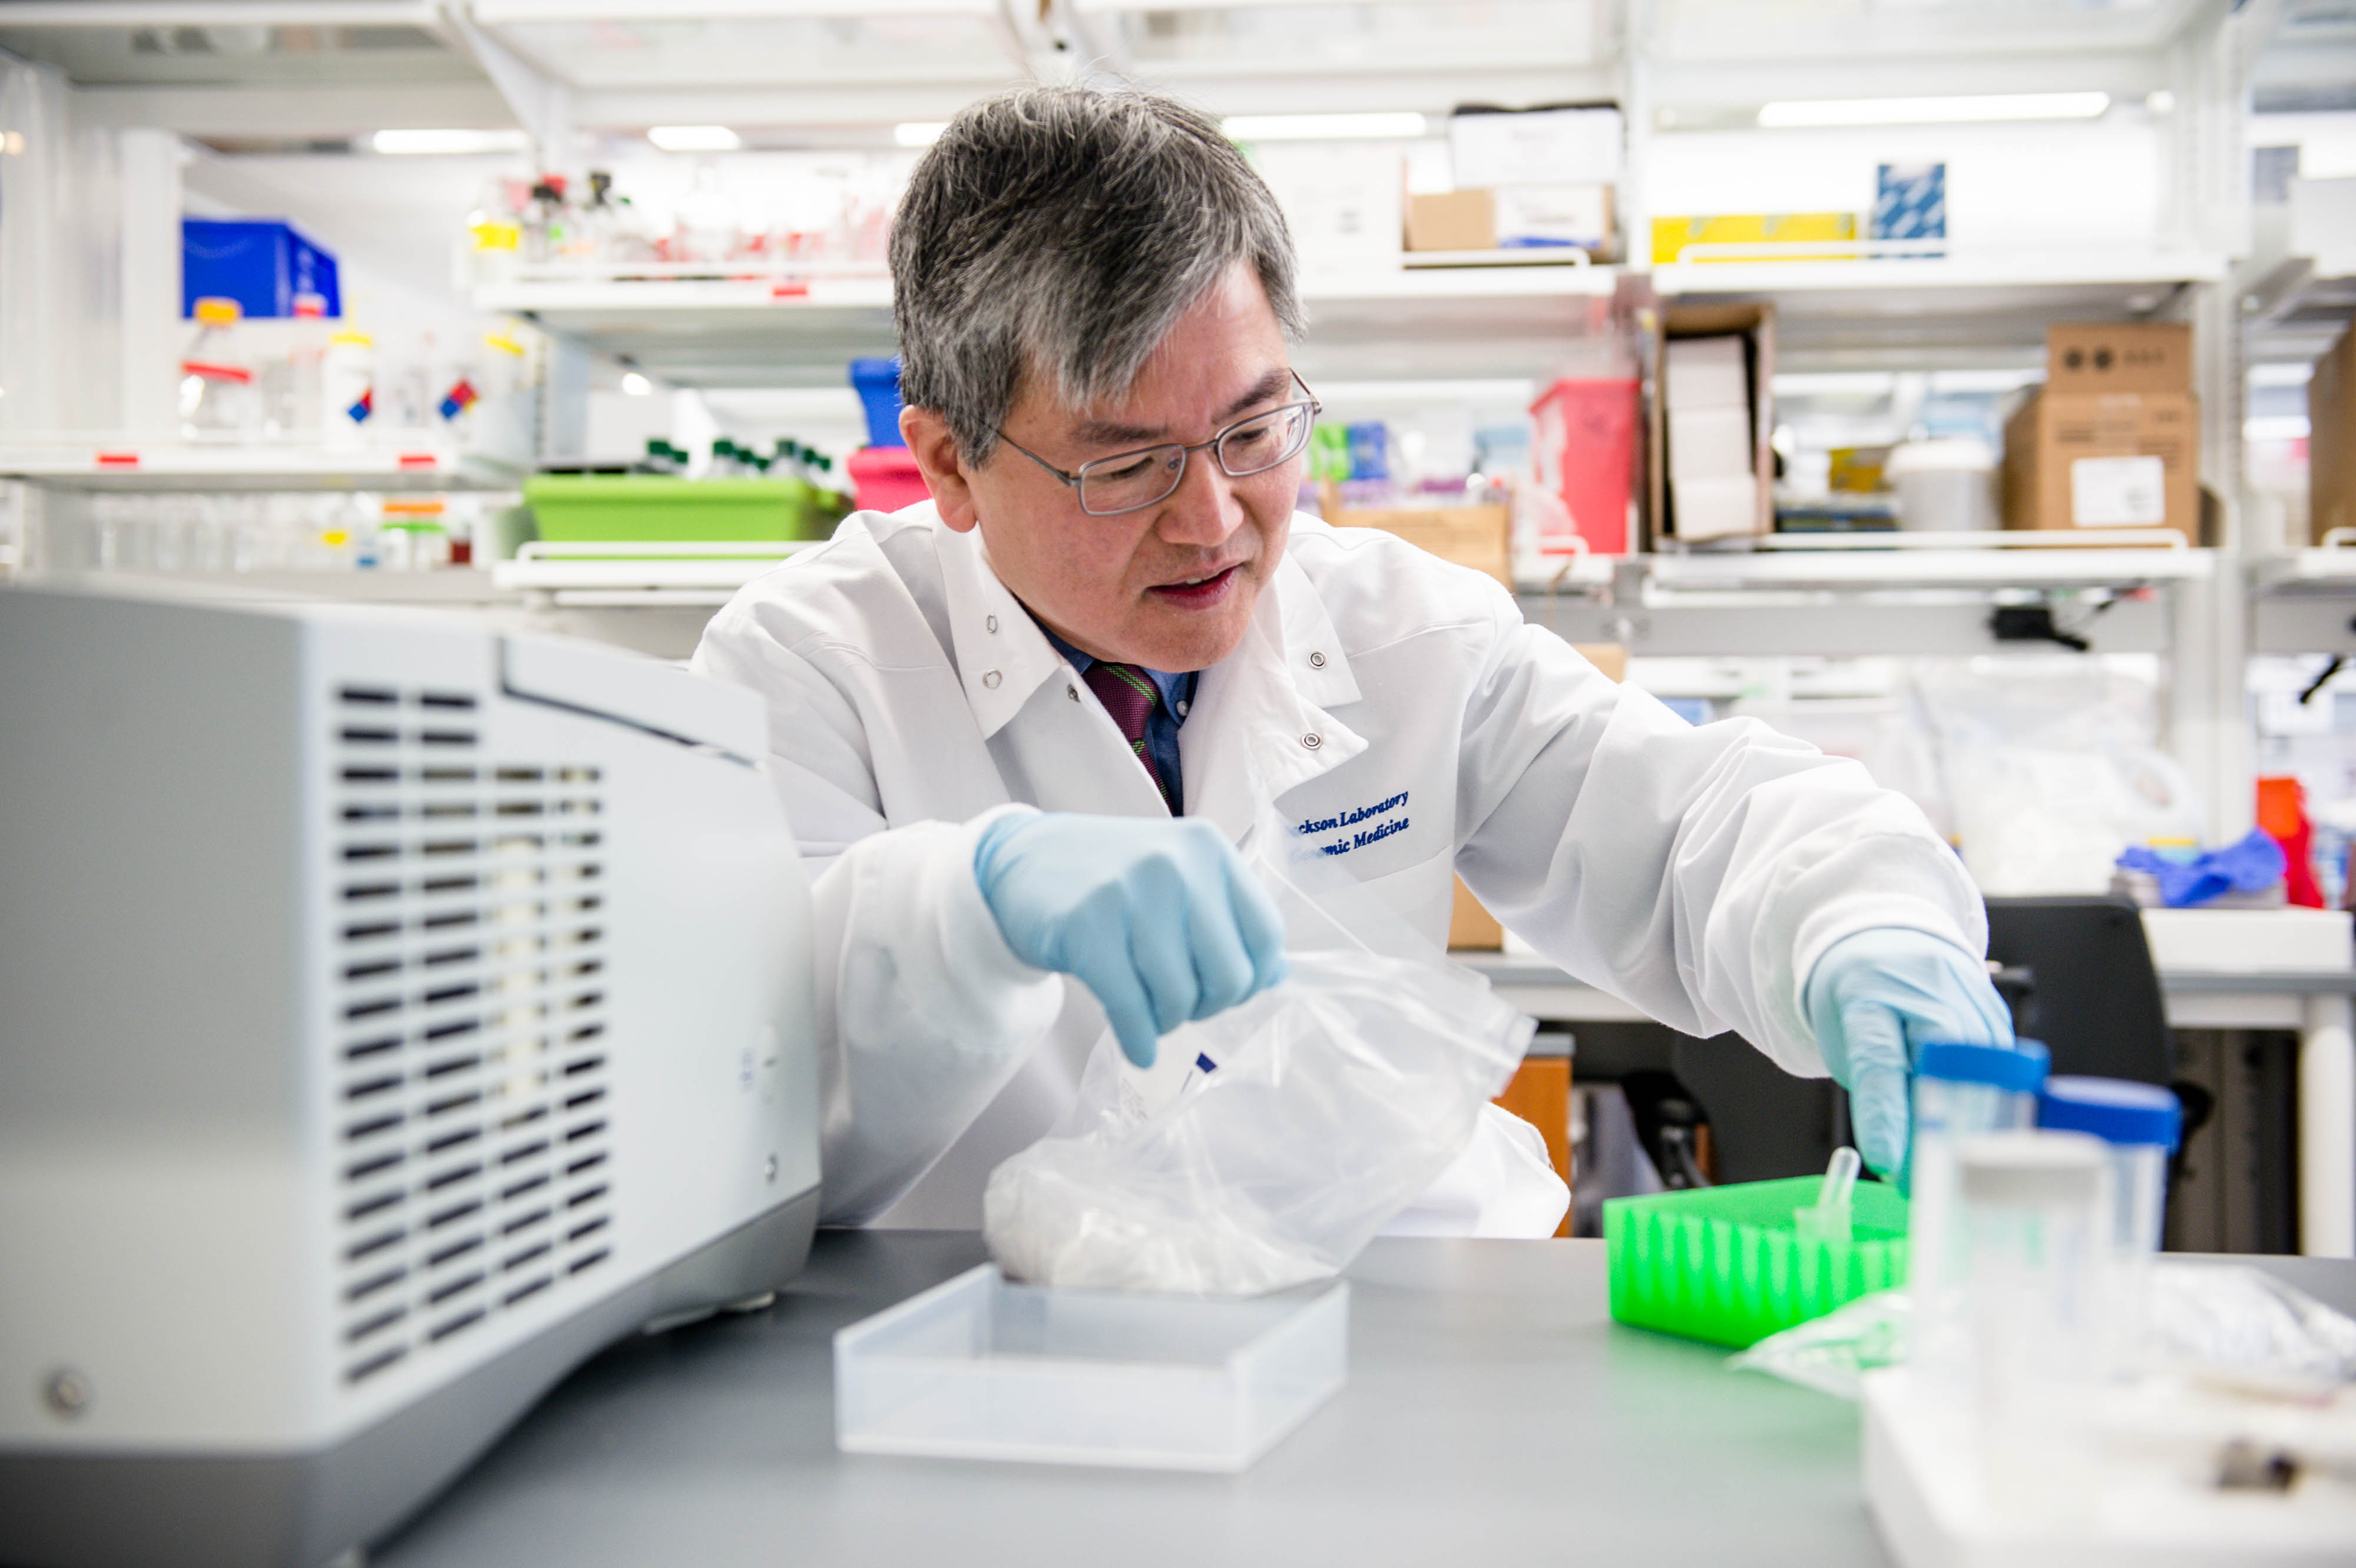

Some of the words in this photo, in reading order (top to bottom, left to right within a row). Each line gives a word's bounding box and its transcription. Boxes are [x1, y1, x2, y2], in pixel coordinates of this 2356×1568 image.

[1294, 819, 1338, 835] ckson
[1339, 791, 1408, 826] Laboratory
[1353, 818, 1409, 849] Medicine
